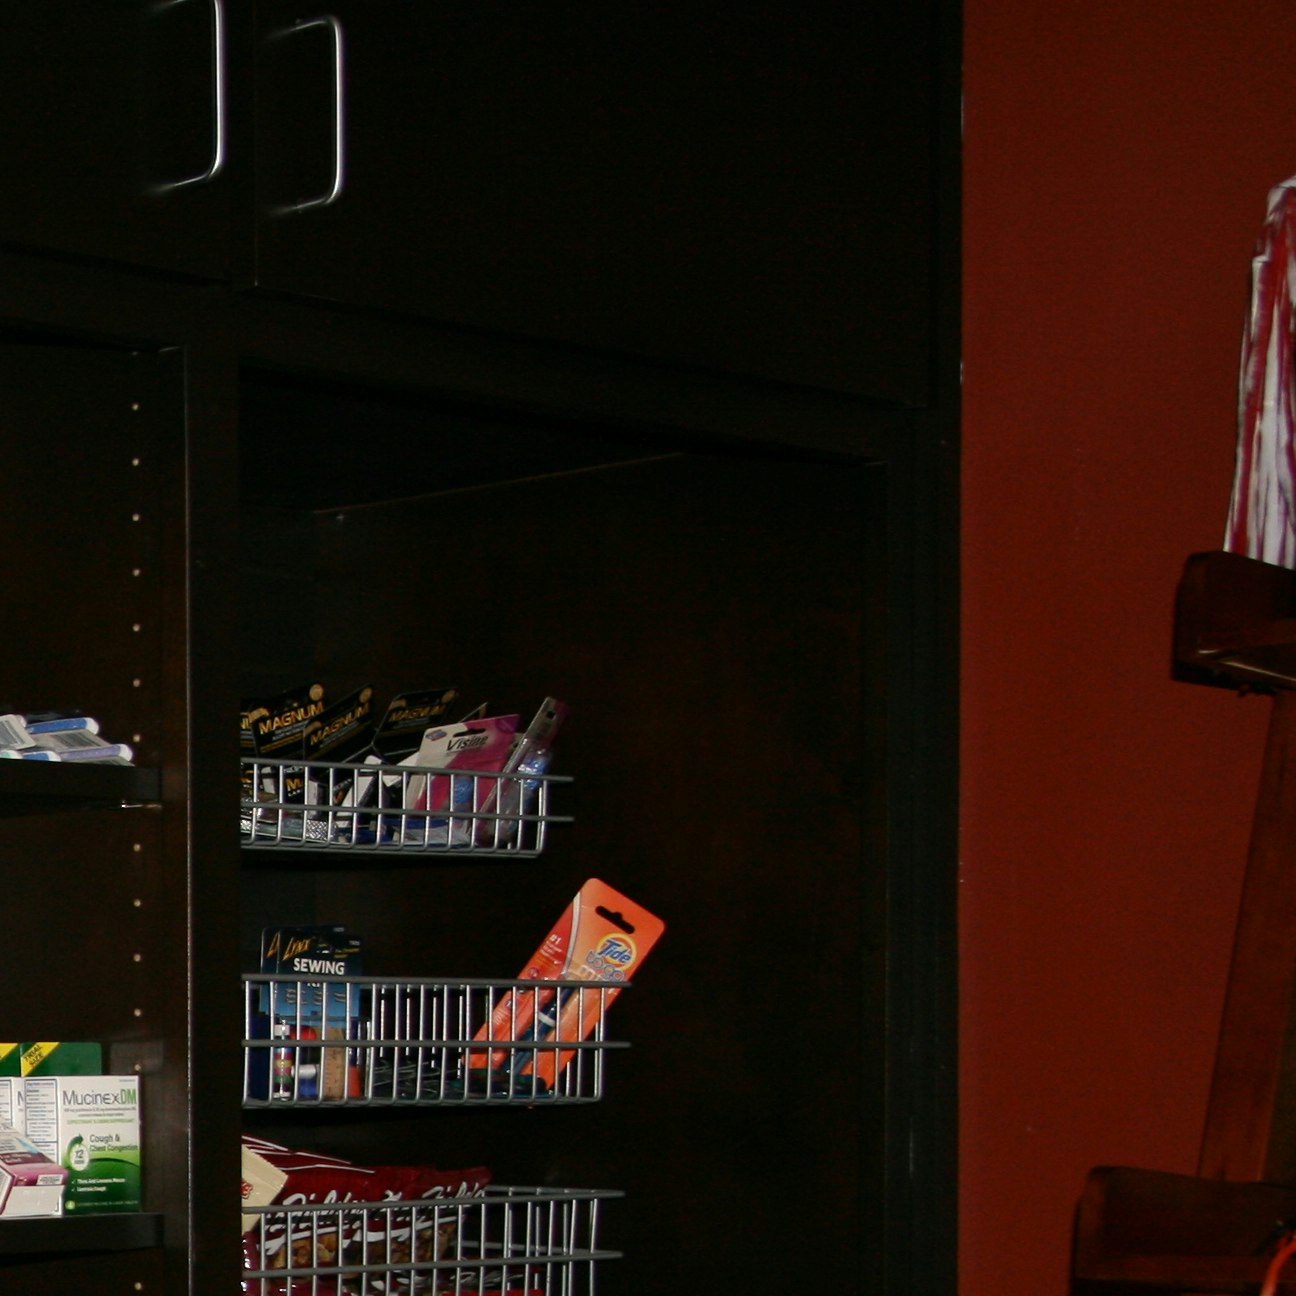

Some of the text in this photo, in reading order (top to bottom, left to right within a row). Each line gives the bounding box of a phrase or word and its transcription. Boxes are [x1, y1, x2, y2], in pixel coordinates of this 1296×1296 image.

[259, 702, 325, 735] MAGNUM
[309, 701, 370, 745] MAGNUM
[293, 957, 346, 976] SEWING
[596, 938, 632, 965] Tide
